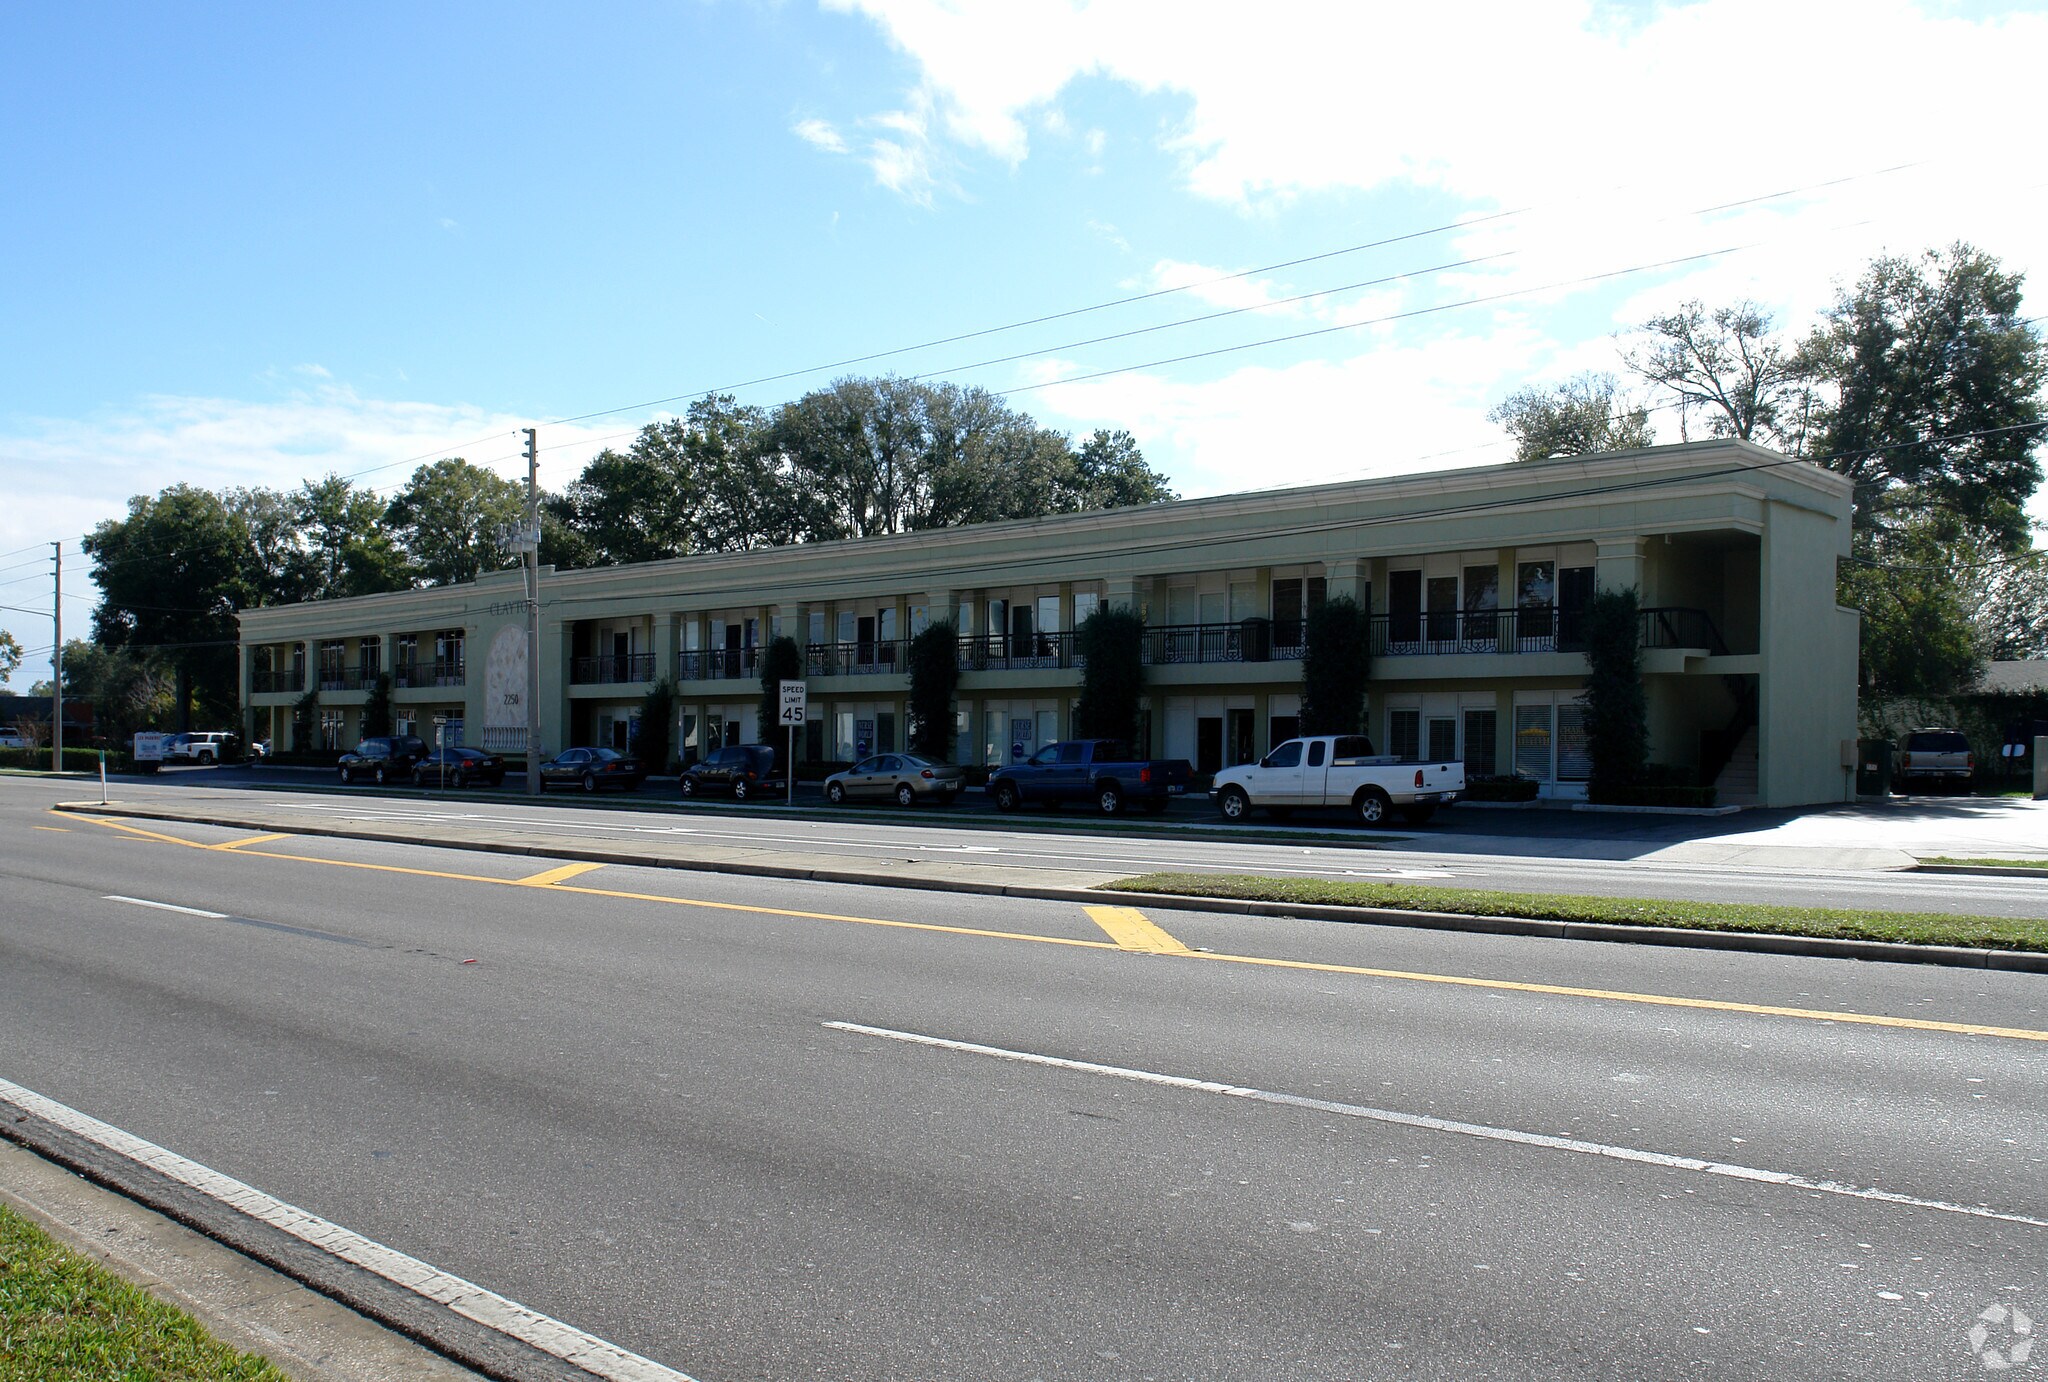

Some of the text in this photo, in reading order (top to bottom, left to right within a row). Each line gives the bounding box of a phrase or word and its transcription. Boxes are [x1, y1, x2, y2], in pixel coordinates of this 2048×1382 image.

[490, 600, 528, 616] CLAYTO
[782, 685, 804, 693] SPEED
[503, 693, 519, 705] 2250
[784, 696, 802, 704] LIMIT
[782, 707, 804, 721] 45
